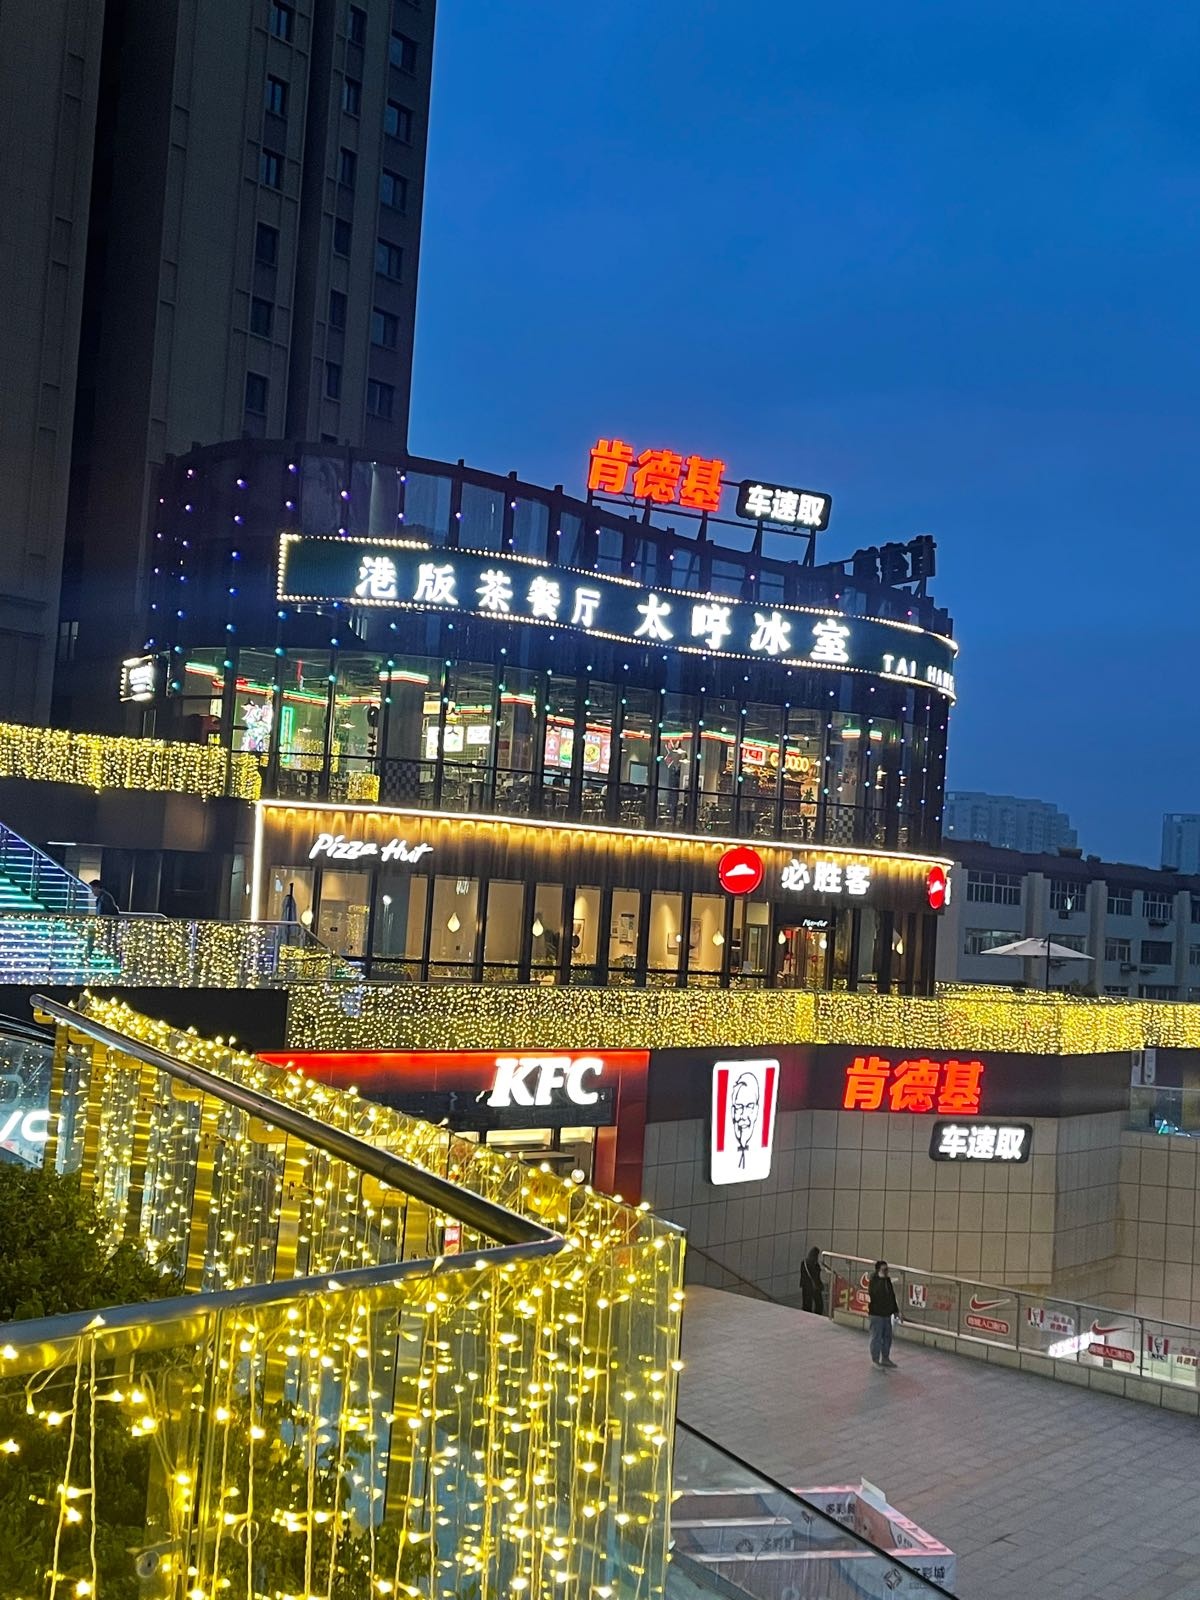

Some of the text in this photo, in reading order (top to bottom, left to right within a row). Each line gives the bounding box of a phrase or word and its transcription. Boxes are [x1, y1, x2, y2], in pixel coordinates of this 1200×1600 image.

[589, 440, 725, 512] 肯德基
[745, 484, 825, 526] 车速取
[355, 556, 851, 664] 港版茶餐厅 太哼冰室
[882, 654, 917, 677] TAI
[309, 833, 434, 863] Pizza Hut
[781, 859, 871, 895] 必胜客
[486, 1057, 604, 1108] KFC
[843, 1057, 984, 1114] 肯德基
[938, 1124, 1025, 1160] 车速取
